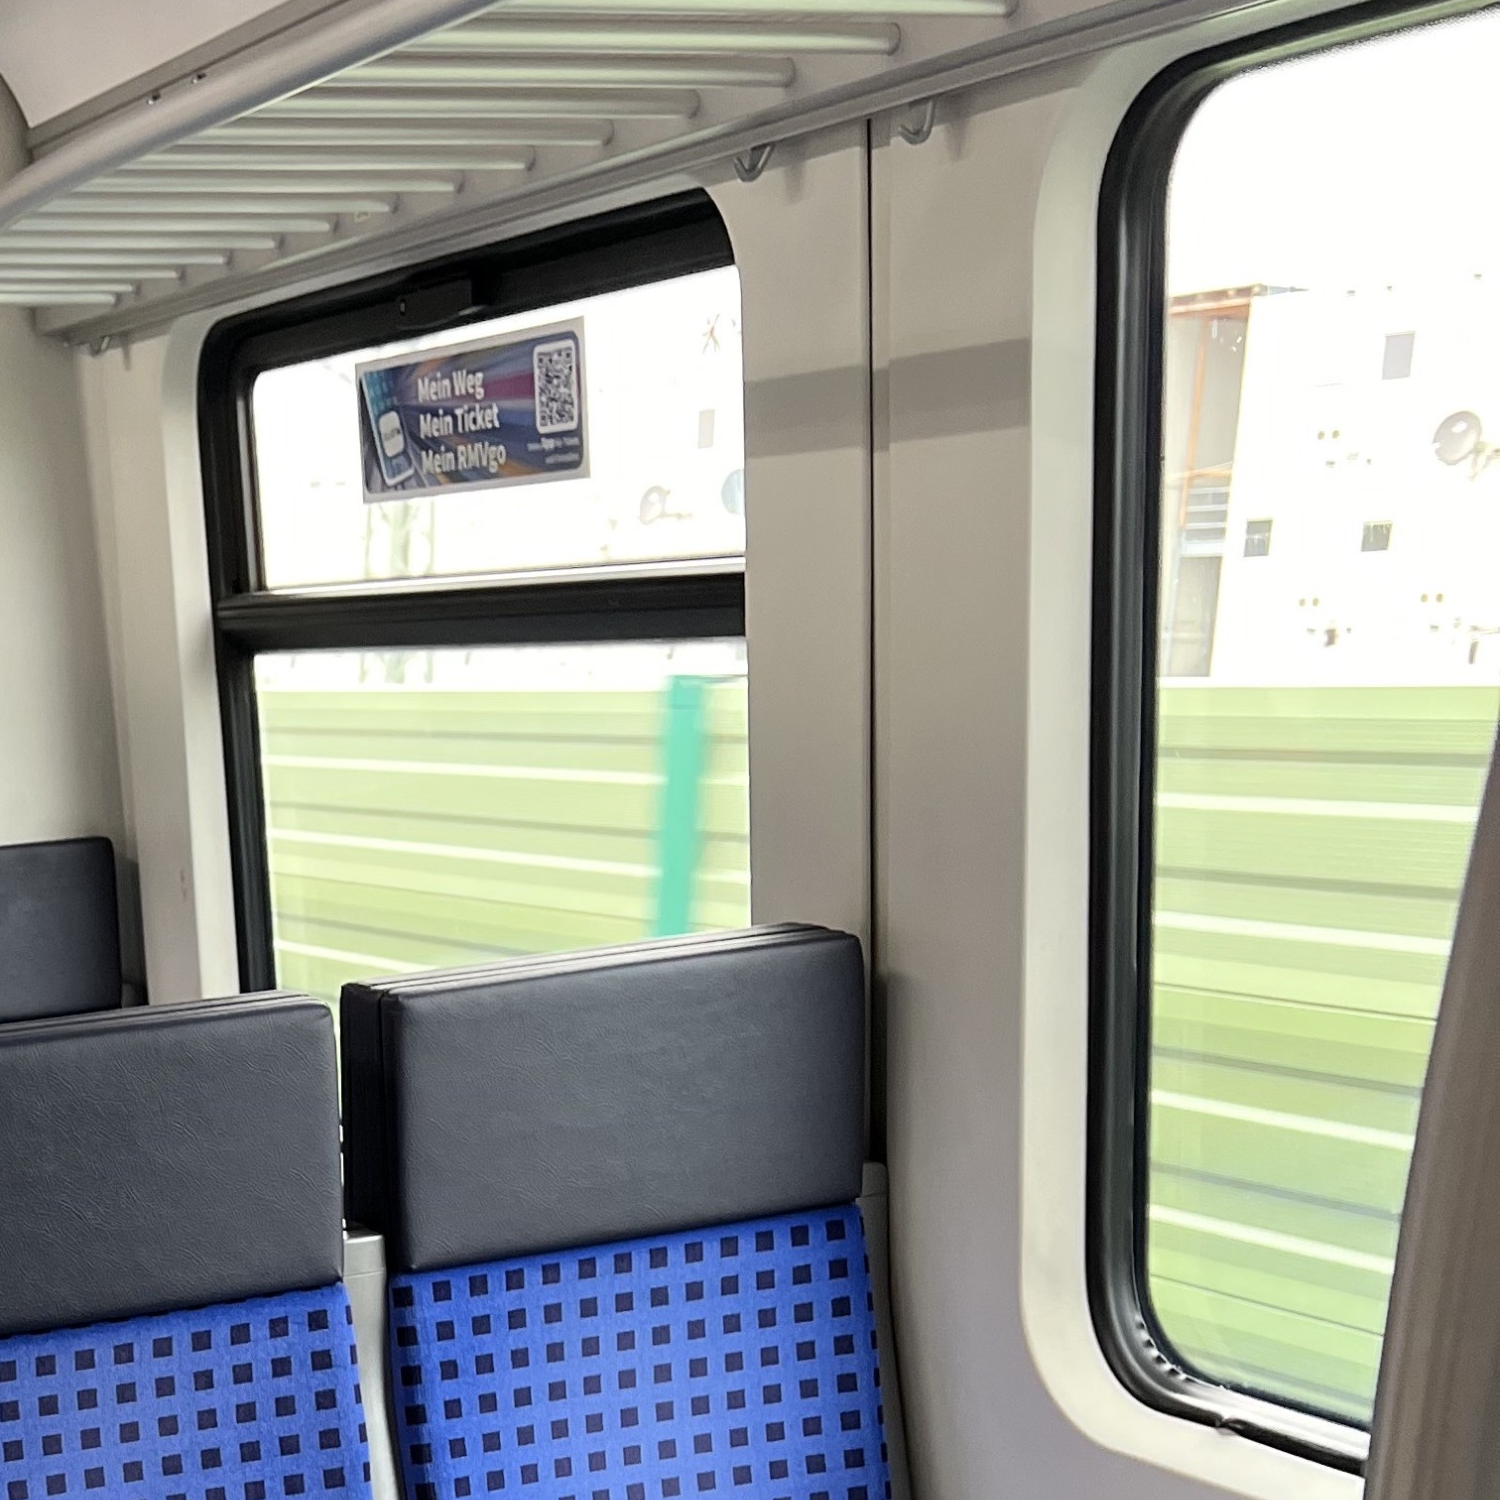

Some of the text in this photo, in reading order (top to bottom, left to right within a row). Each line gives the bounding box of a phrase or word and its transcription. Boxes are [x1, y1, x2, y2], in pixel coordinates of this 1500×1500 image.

[417, 369, 485, 403] Mein Weg
[419, 408, 453, 439] Mein
[454, 402, 499, 433] Ticket
[421, 445, 455, 474] Mein
[457, 441, 506, 473] RMVgo
